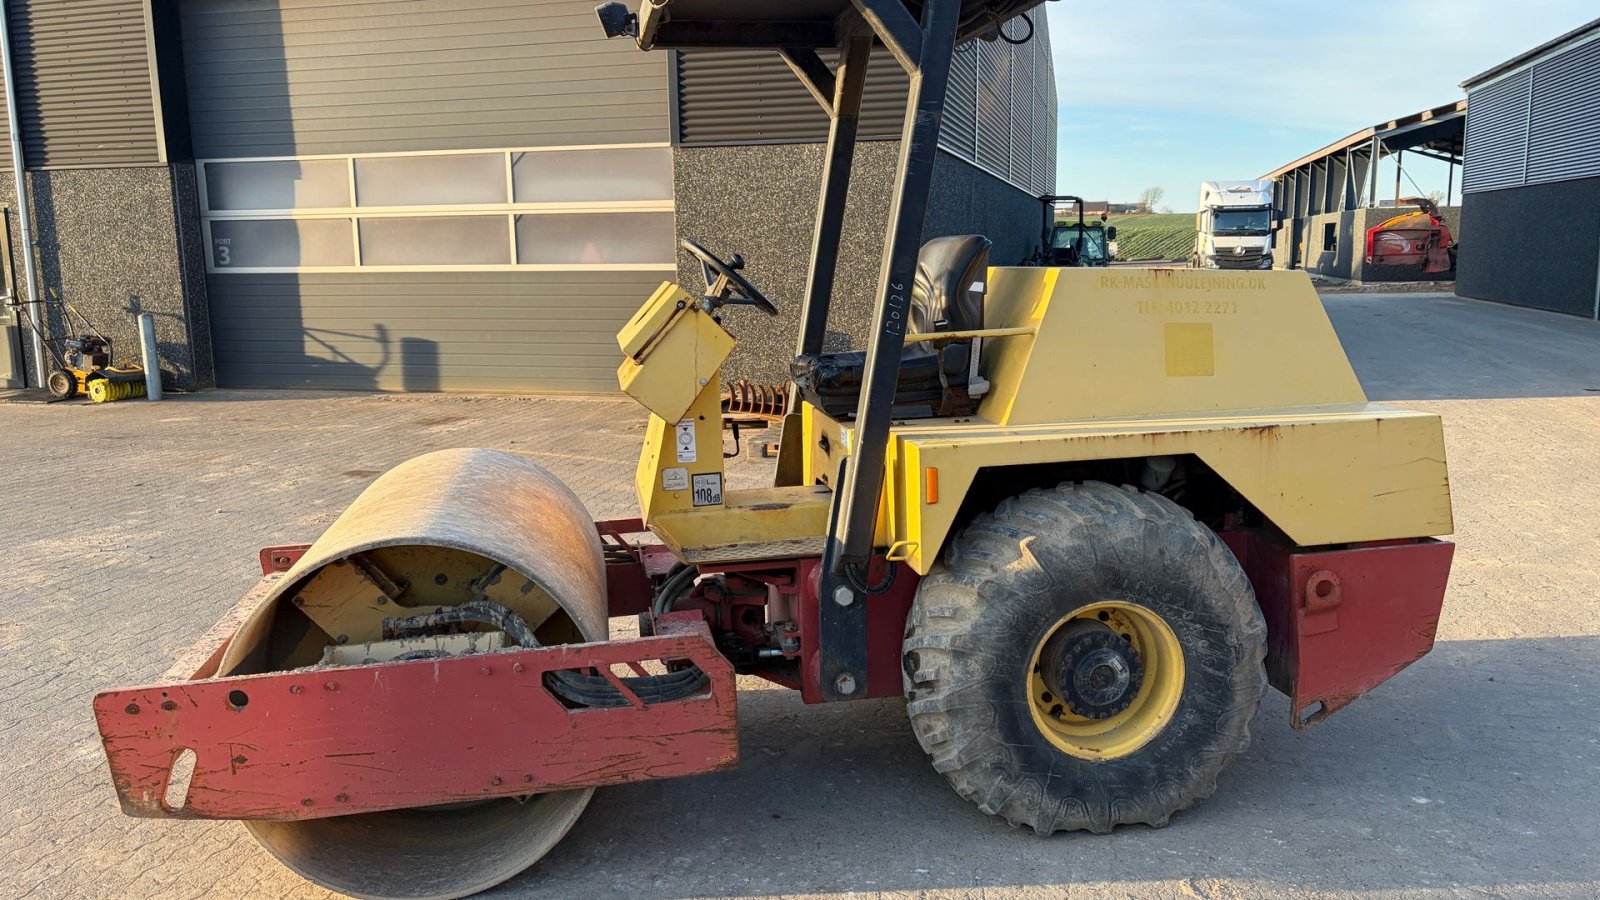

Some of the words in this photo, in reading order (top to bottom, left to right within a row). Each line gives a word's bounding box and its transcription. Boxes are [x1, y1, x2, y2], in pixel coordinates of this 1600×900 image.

[219, 246, 231, 265] 3
[1166, 301, 1200, 314] 4012
[1205, 301, 1238, 314] 2271
